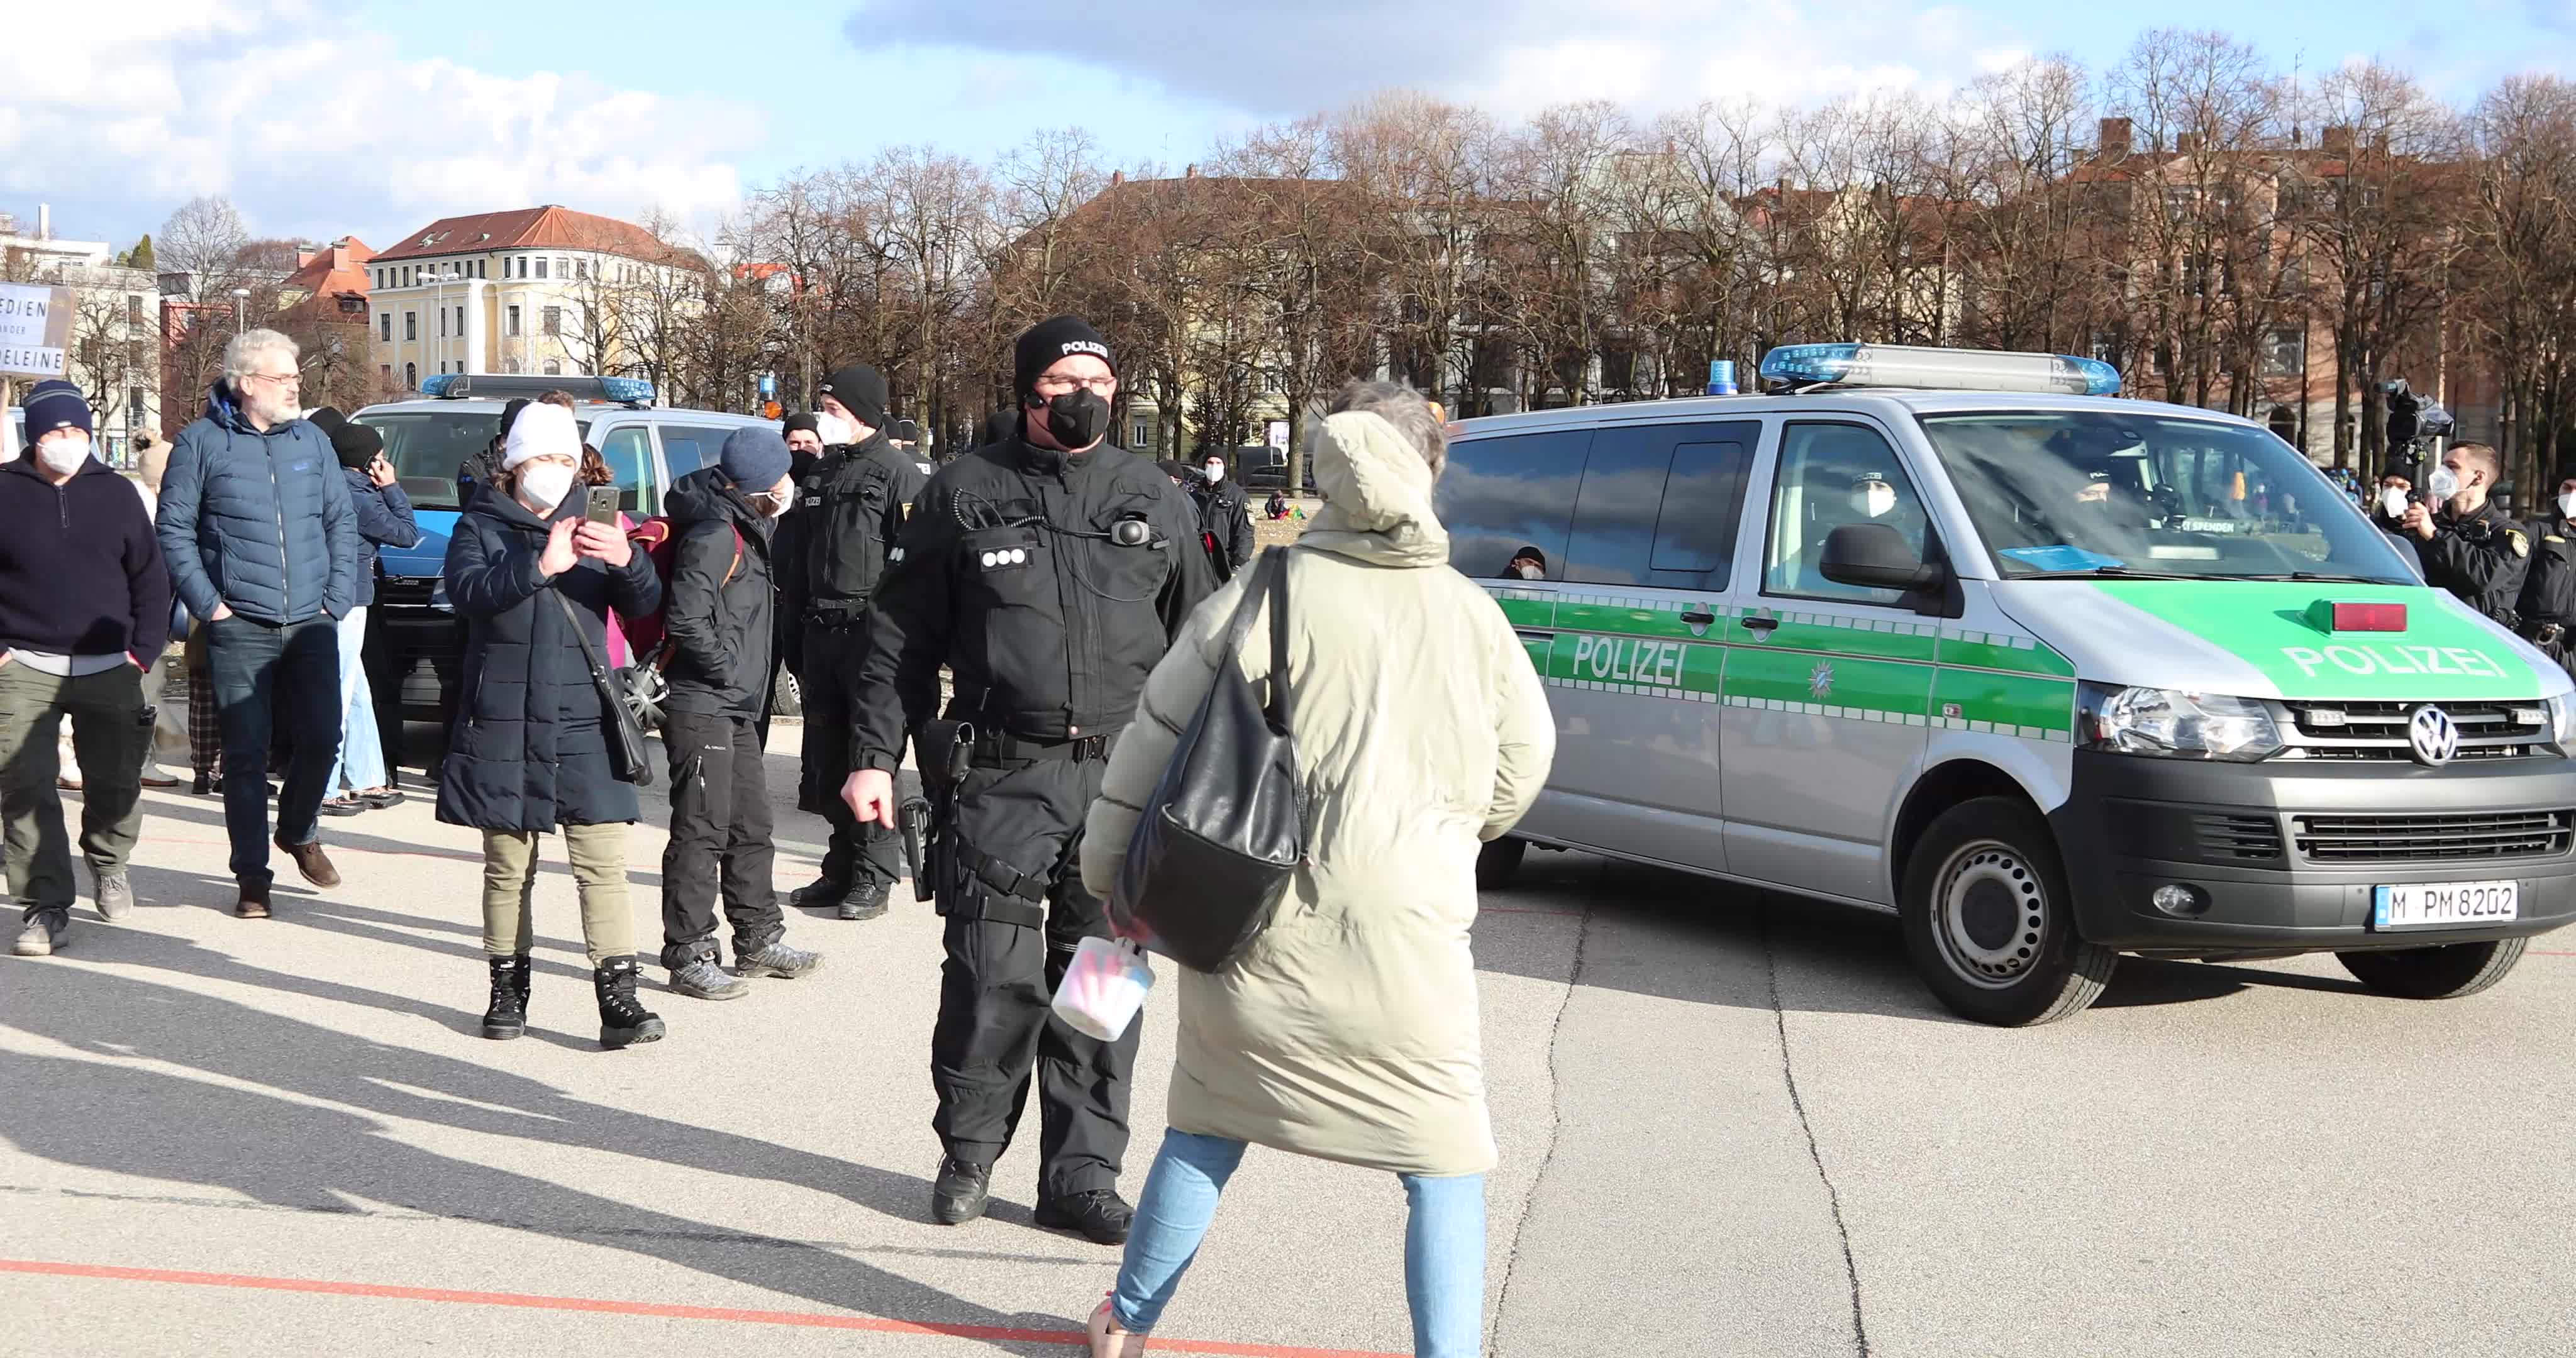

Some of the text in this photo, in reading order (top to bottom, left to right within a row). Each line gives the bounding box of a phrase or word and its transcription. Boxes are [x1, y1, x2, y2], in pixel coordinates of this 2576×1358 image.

[0, 348, 62, 370] ELEINE
[1574, 636, 1687, 686] POLIZEI
[2280, 646, 2508, 677] POLIZEI
[2412, 708, 2457, 763] VW
[2392, 887, 2512, 919] M PM 8202
